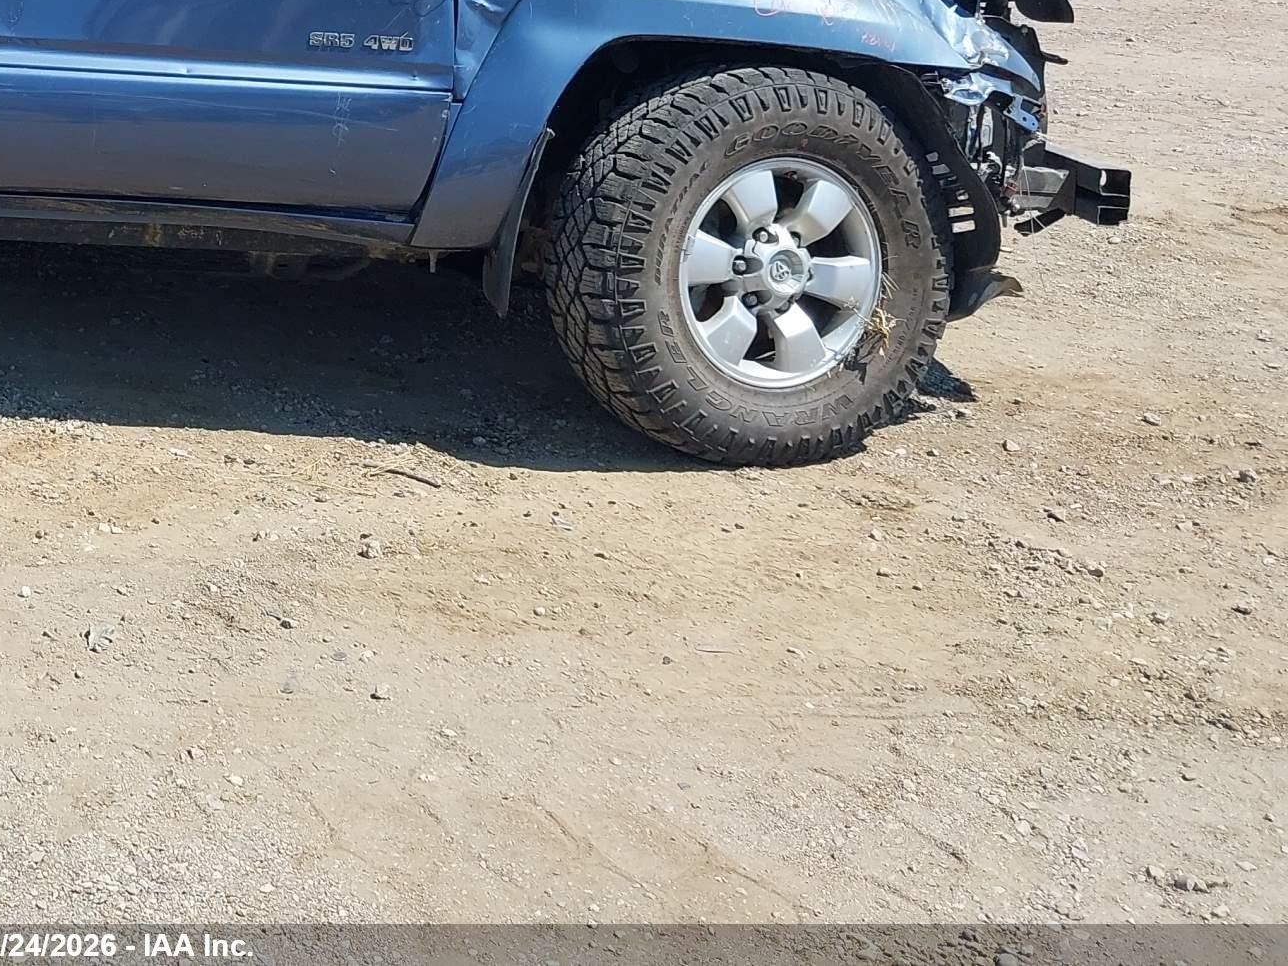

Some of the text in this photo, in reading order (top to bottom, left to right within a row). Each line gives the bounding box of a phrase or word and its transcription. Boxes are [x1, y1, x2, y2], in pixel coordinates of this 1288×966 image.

[309, 31, 415, 52] SR5 4WD
[723, 121, 922, 250] GOODYEAR
[657, 307, 854, 427] WRANGLER
